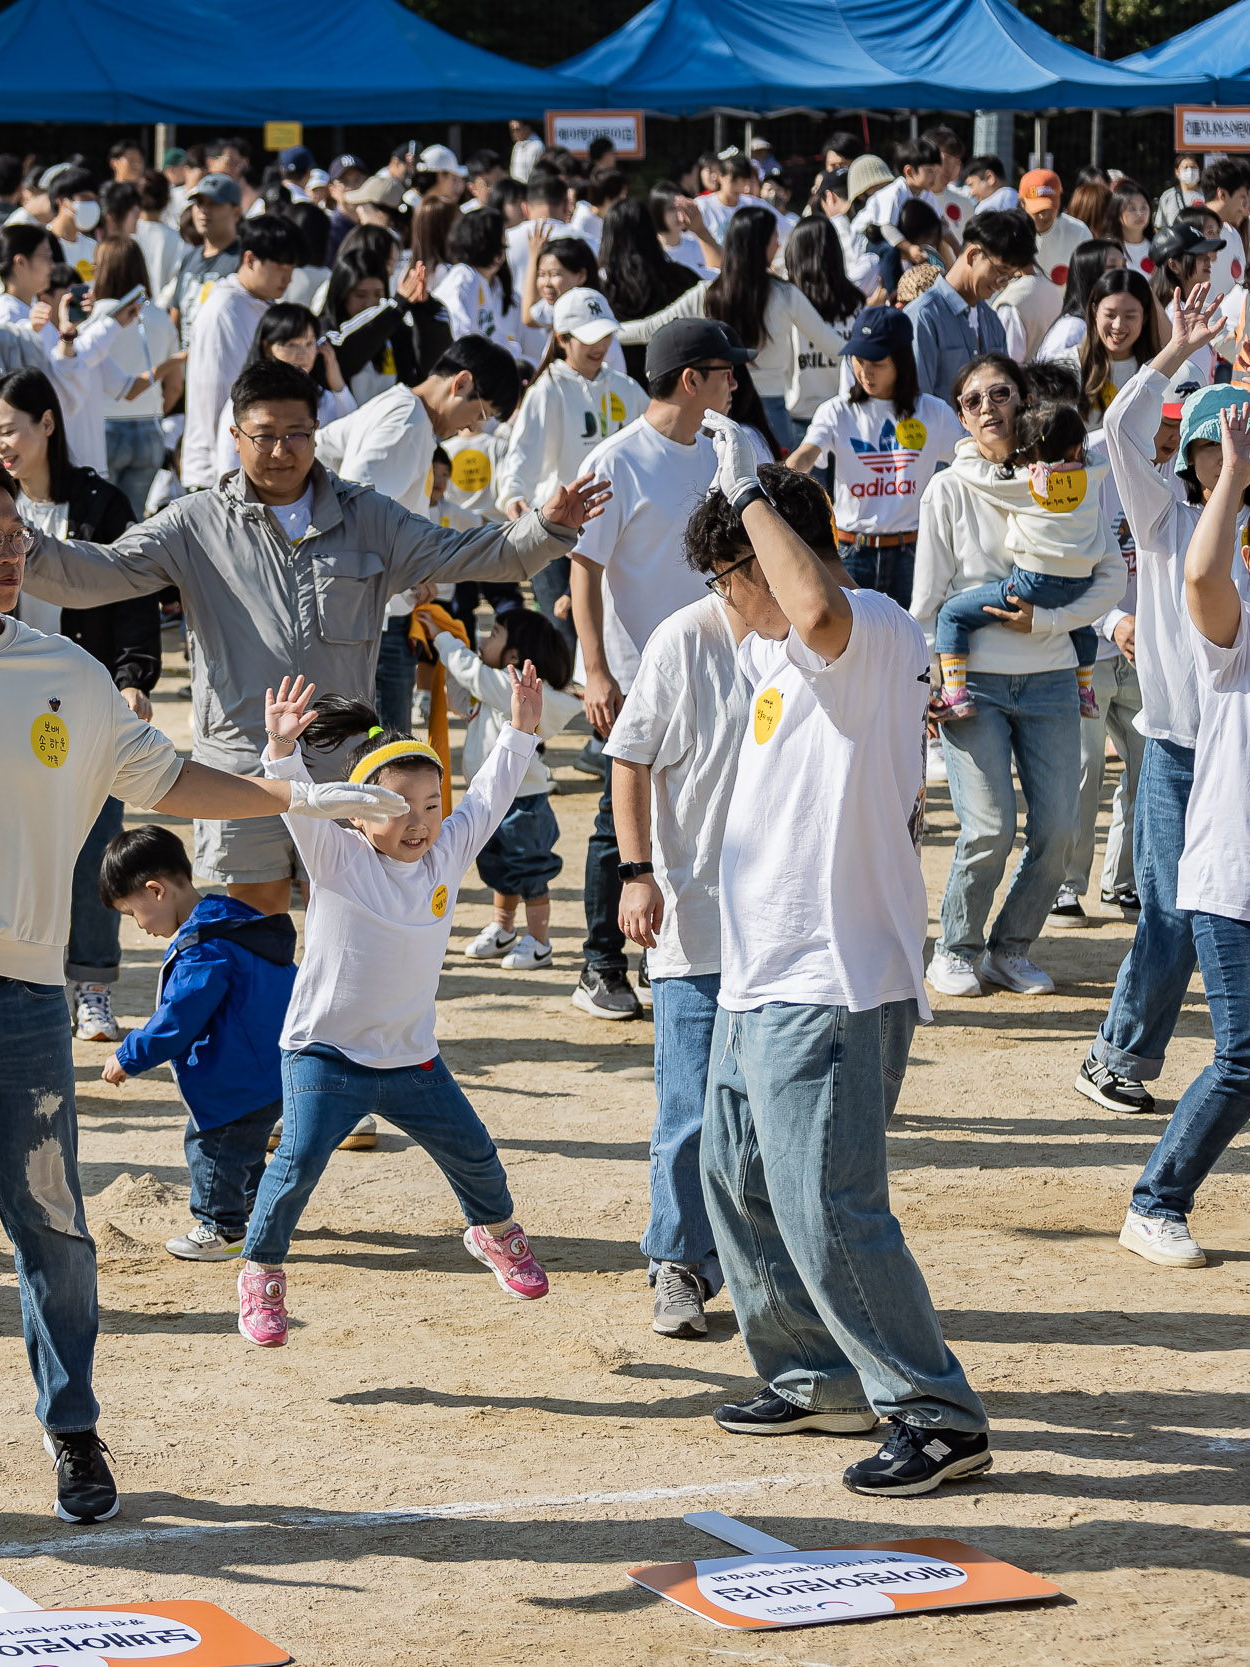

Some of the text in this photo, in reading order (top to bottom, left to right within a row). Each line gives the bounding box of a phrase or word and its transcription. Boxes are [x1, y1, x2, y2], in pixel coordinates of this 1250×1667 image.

[851, 477, 917, 498] adidas
[45, 721, 60, 734] 보배
[713, 1567, 966, 1603] 예아랑어린이집
